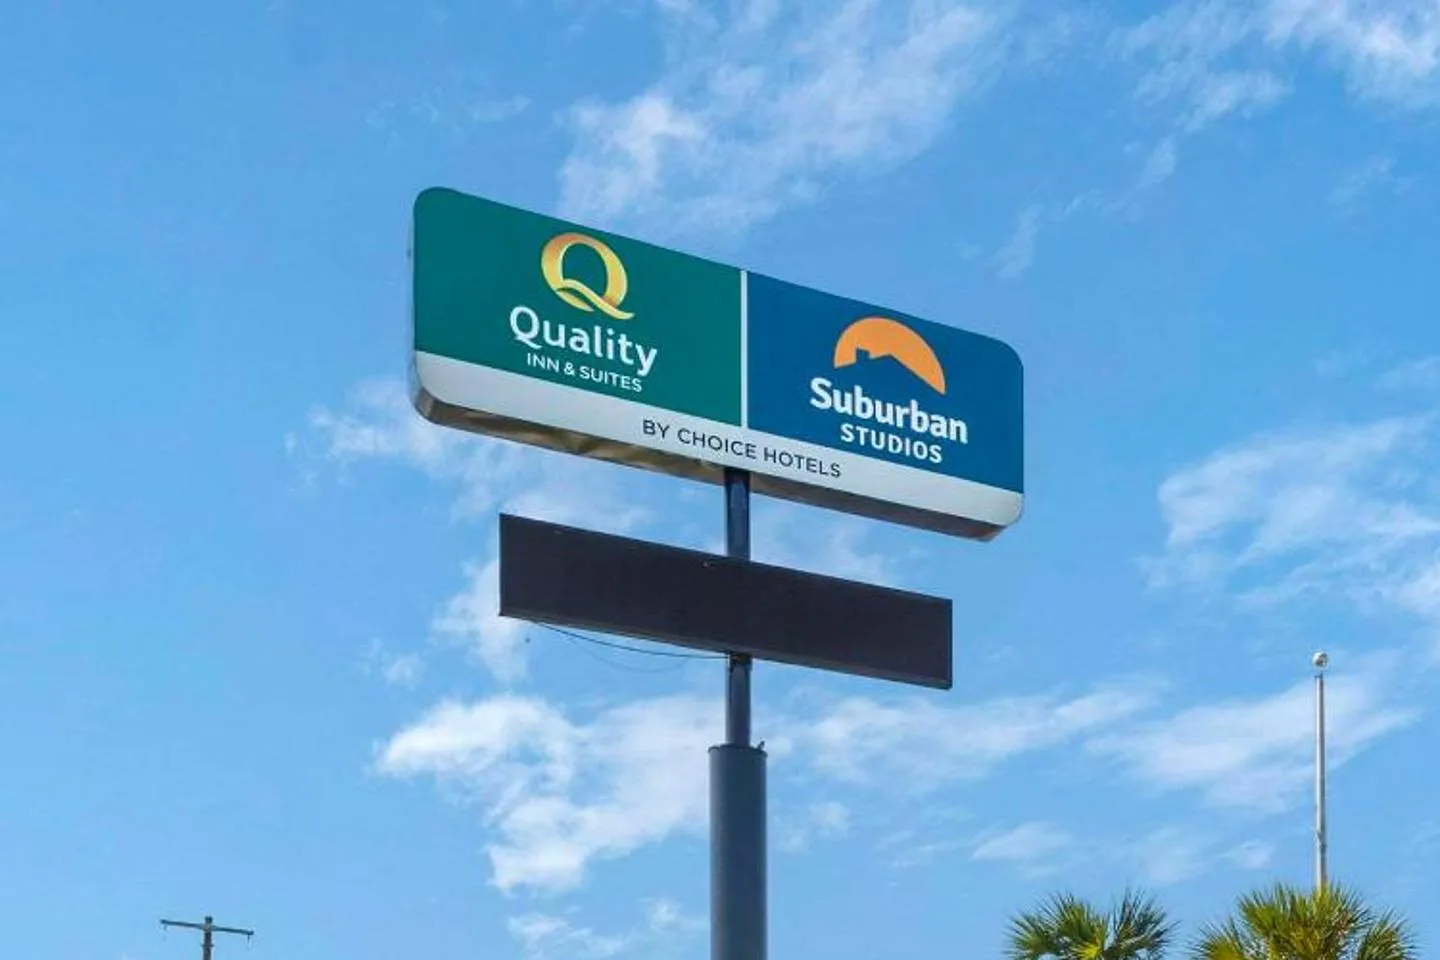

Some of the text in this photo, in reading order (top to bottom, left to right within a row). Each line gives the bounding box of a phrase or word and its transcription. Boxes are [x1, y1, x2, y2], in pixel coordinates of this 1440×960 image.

[509, 306, 657, 377] Quality
[527, 352, 643, 393] INN & SUITES
[810, 377, 968, 444] Suburban
[642, 419, 842, 478] BY CHOICE HOTELS
[840, 423, 943, 464] STUDIOS
